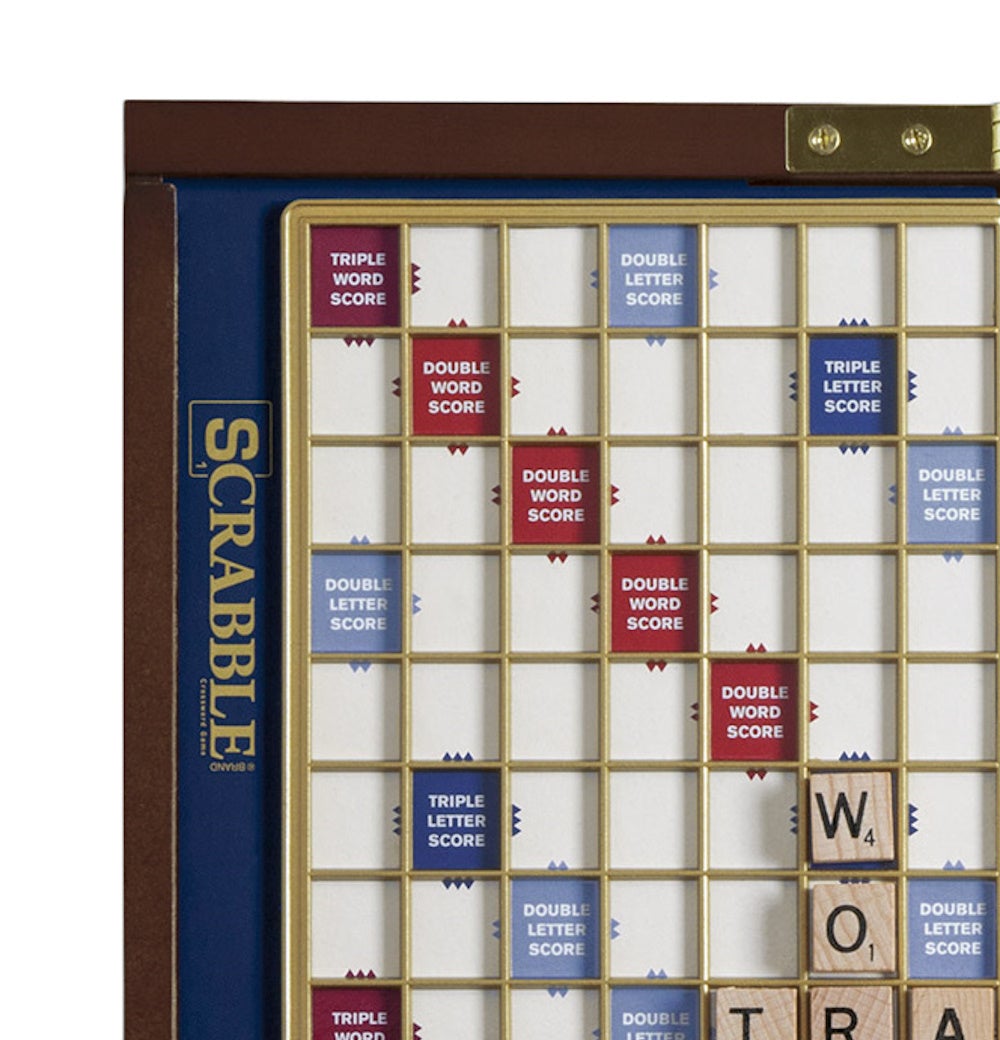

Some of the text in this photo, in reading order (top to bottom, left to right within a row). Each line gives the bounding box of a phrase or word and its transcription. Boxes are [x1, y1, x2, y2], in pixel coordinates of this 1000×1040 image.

[329, 251, 387, 267] TRIPLE
[620, 252, 687, 268] DOUBLE
[332, 271, 385, 287] WORD
[624, 272, 684, 287] LETTER
[329, 291, 387, 307] SCORE
[625, 291, 684, 307] SCORE
[422, 360, 491, 376] DOUBLE
[823, 360, 882, 375] TRIPLE
[429, 379, 484, 396] WORD
[822, 379, 883, 394] LETTER
[427, 399, 486, 415] SCORE
[824, 398, 882, 414] SCORE
[521, 468, 590, 484] DOUBLE
[529, 488, 583, 503] WORD
[527, 507, 585, 523] SCORE
[204, 417, 259, 760] SCRABBLE
[621, 576, 689, 592] DOUBLE
[628, 596, 682, 612] WORD
[626, 615, 685, 631] SCORE
[721, 685, 789, 700] DOUBLE
[728, 704, 782, 720] WORD
[726, 724, 784, 740] SCORE
[427, 793, 485, 809] TRIPLE
[426, 813, 487, 828] LETTER
[427, 833, 486, 848] SCORE
[522, 902, 591, 918] DOUBLE
[919, 901, 986, 917] DOUBLE
[527, 922, 587, 937] LETTER
[923, 921, 983, 937] LETTER
[528, 941, 585, 957] SCORE
[924, 940, 982, 956] SCORE
